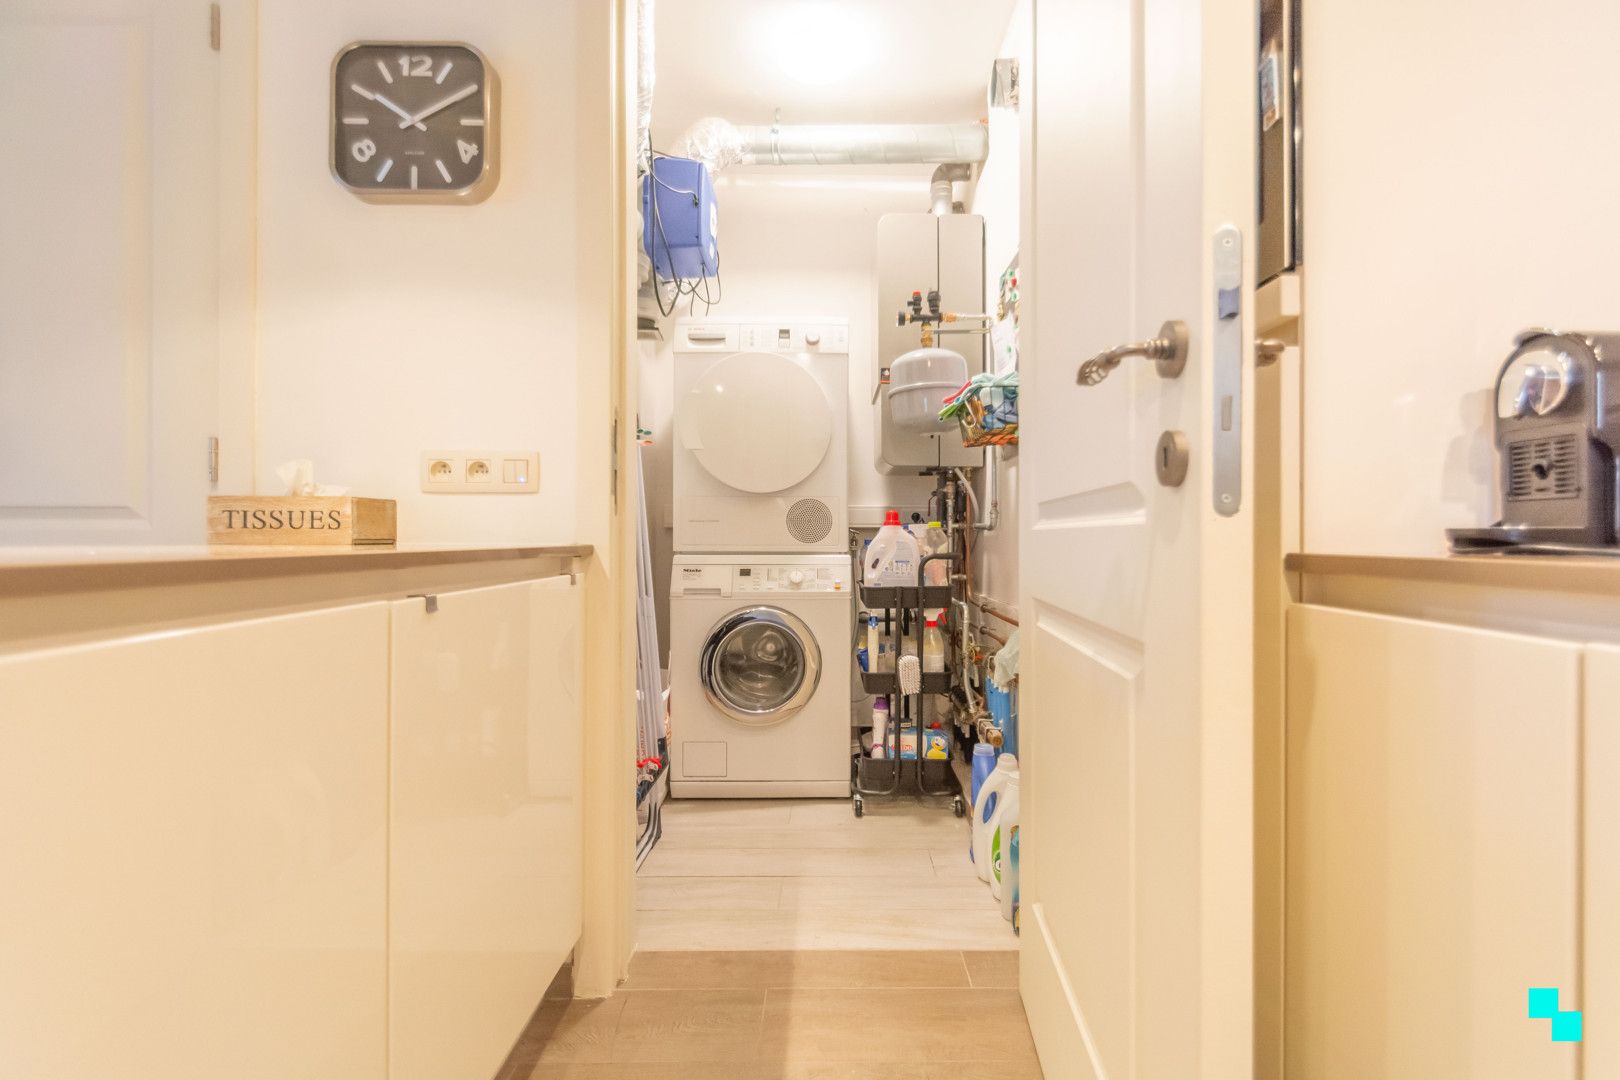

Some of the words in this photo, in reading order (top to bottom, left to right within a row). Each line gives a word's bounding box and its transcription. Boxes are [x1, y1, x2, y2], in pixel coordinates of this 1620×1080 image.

[398, 55, 433, 77] 12
[352, 138, 377, 163] 8
[456, 139, 479, 165] 4
[222, 509, 342, 530] TISSUES
